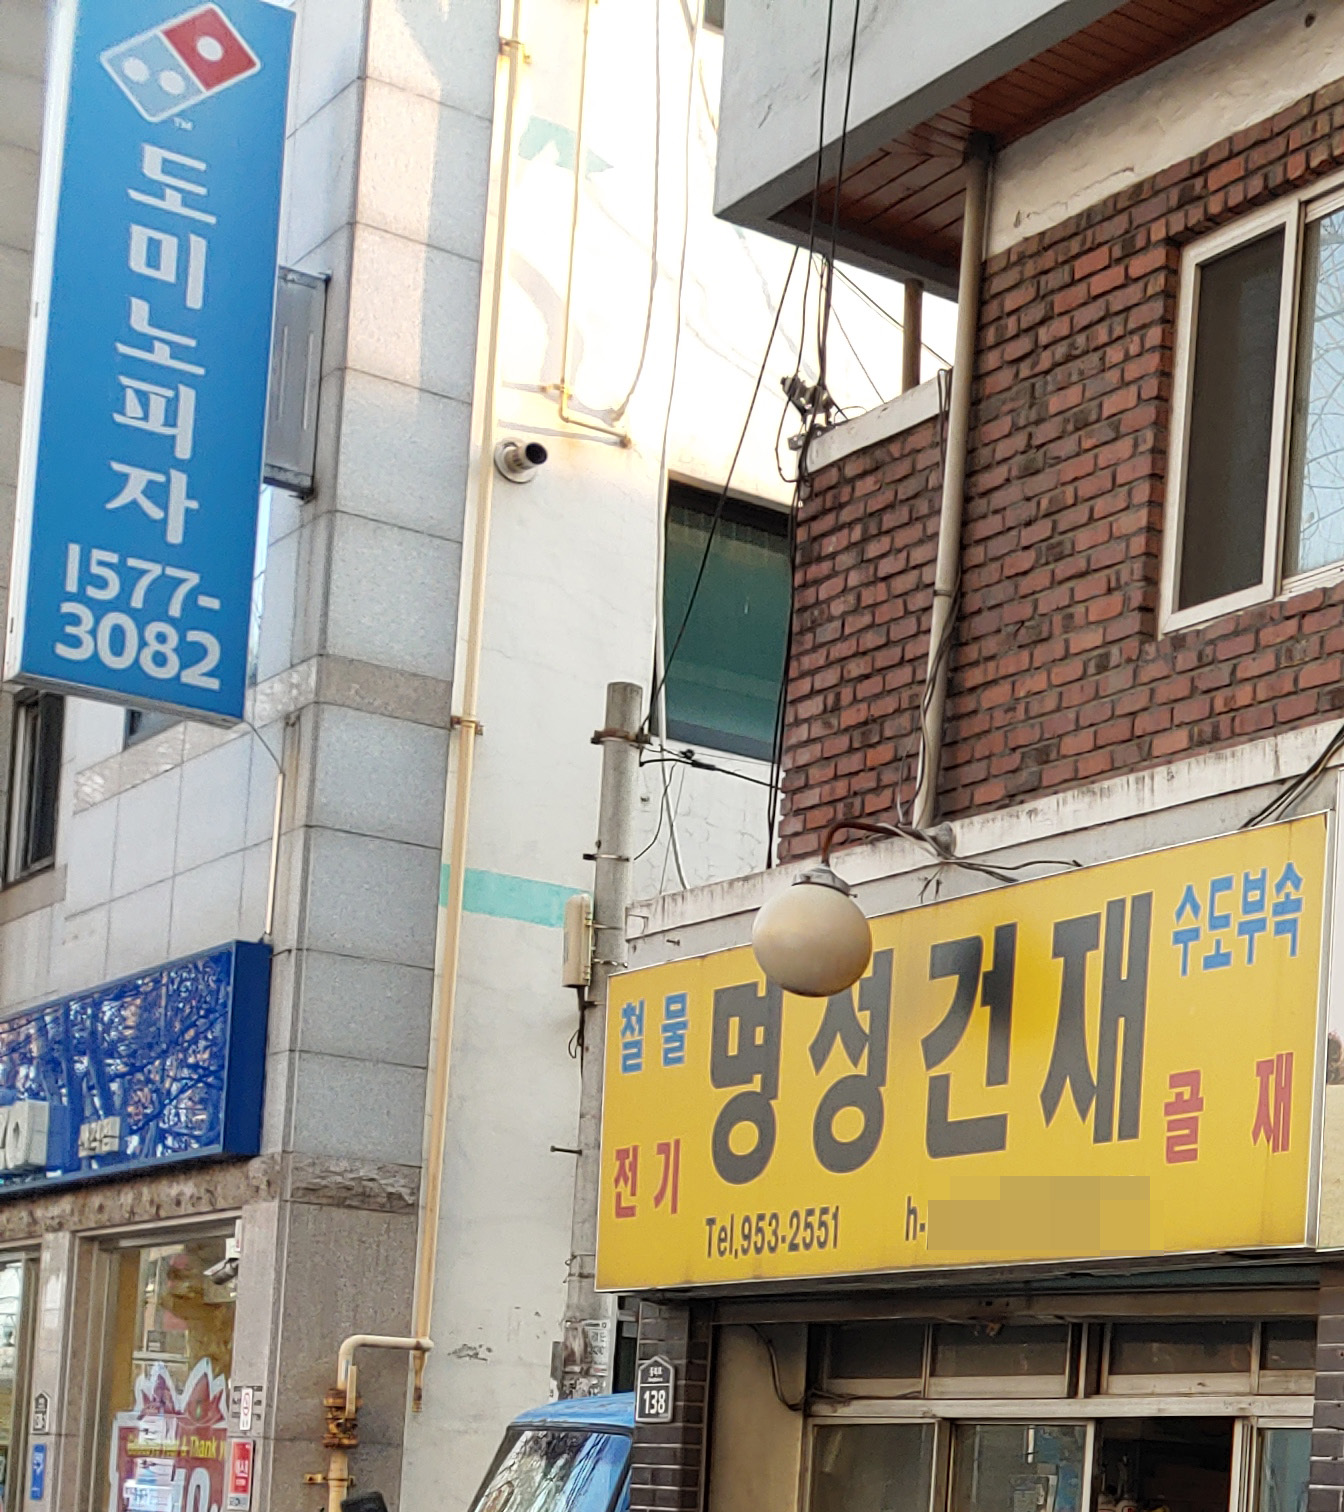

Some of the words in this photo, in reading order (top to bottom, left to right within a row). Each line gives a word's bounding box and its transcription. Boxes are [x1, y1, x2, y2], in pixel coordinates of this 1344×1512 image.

[105, 142, 217, 545] 도미노피자
[64, 541, 222, 612] 1577-
[53, 600, 223, 692] 3082
[1171, 860, 1305, 978] 수도부속
[709, 890, 1155, 1186] 명성건재
[643, 1390, 666, 1415] 138
